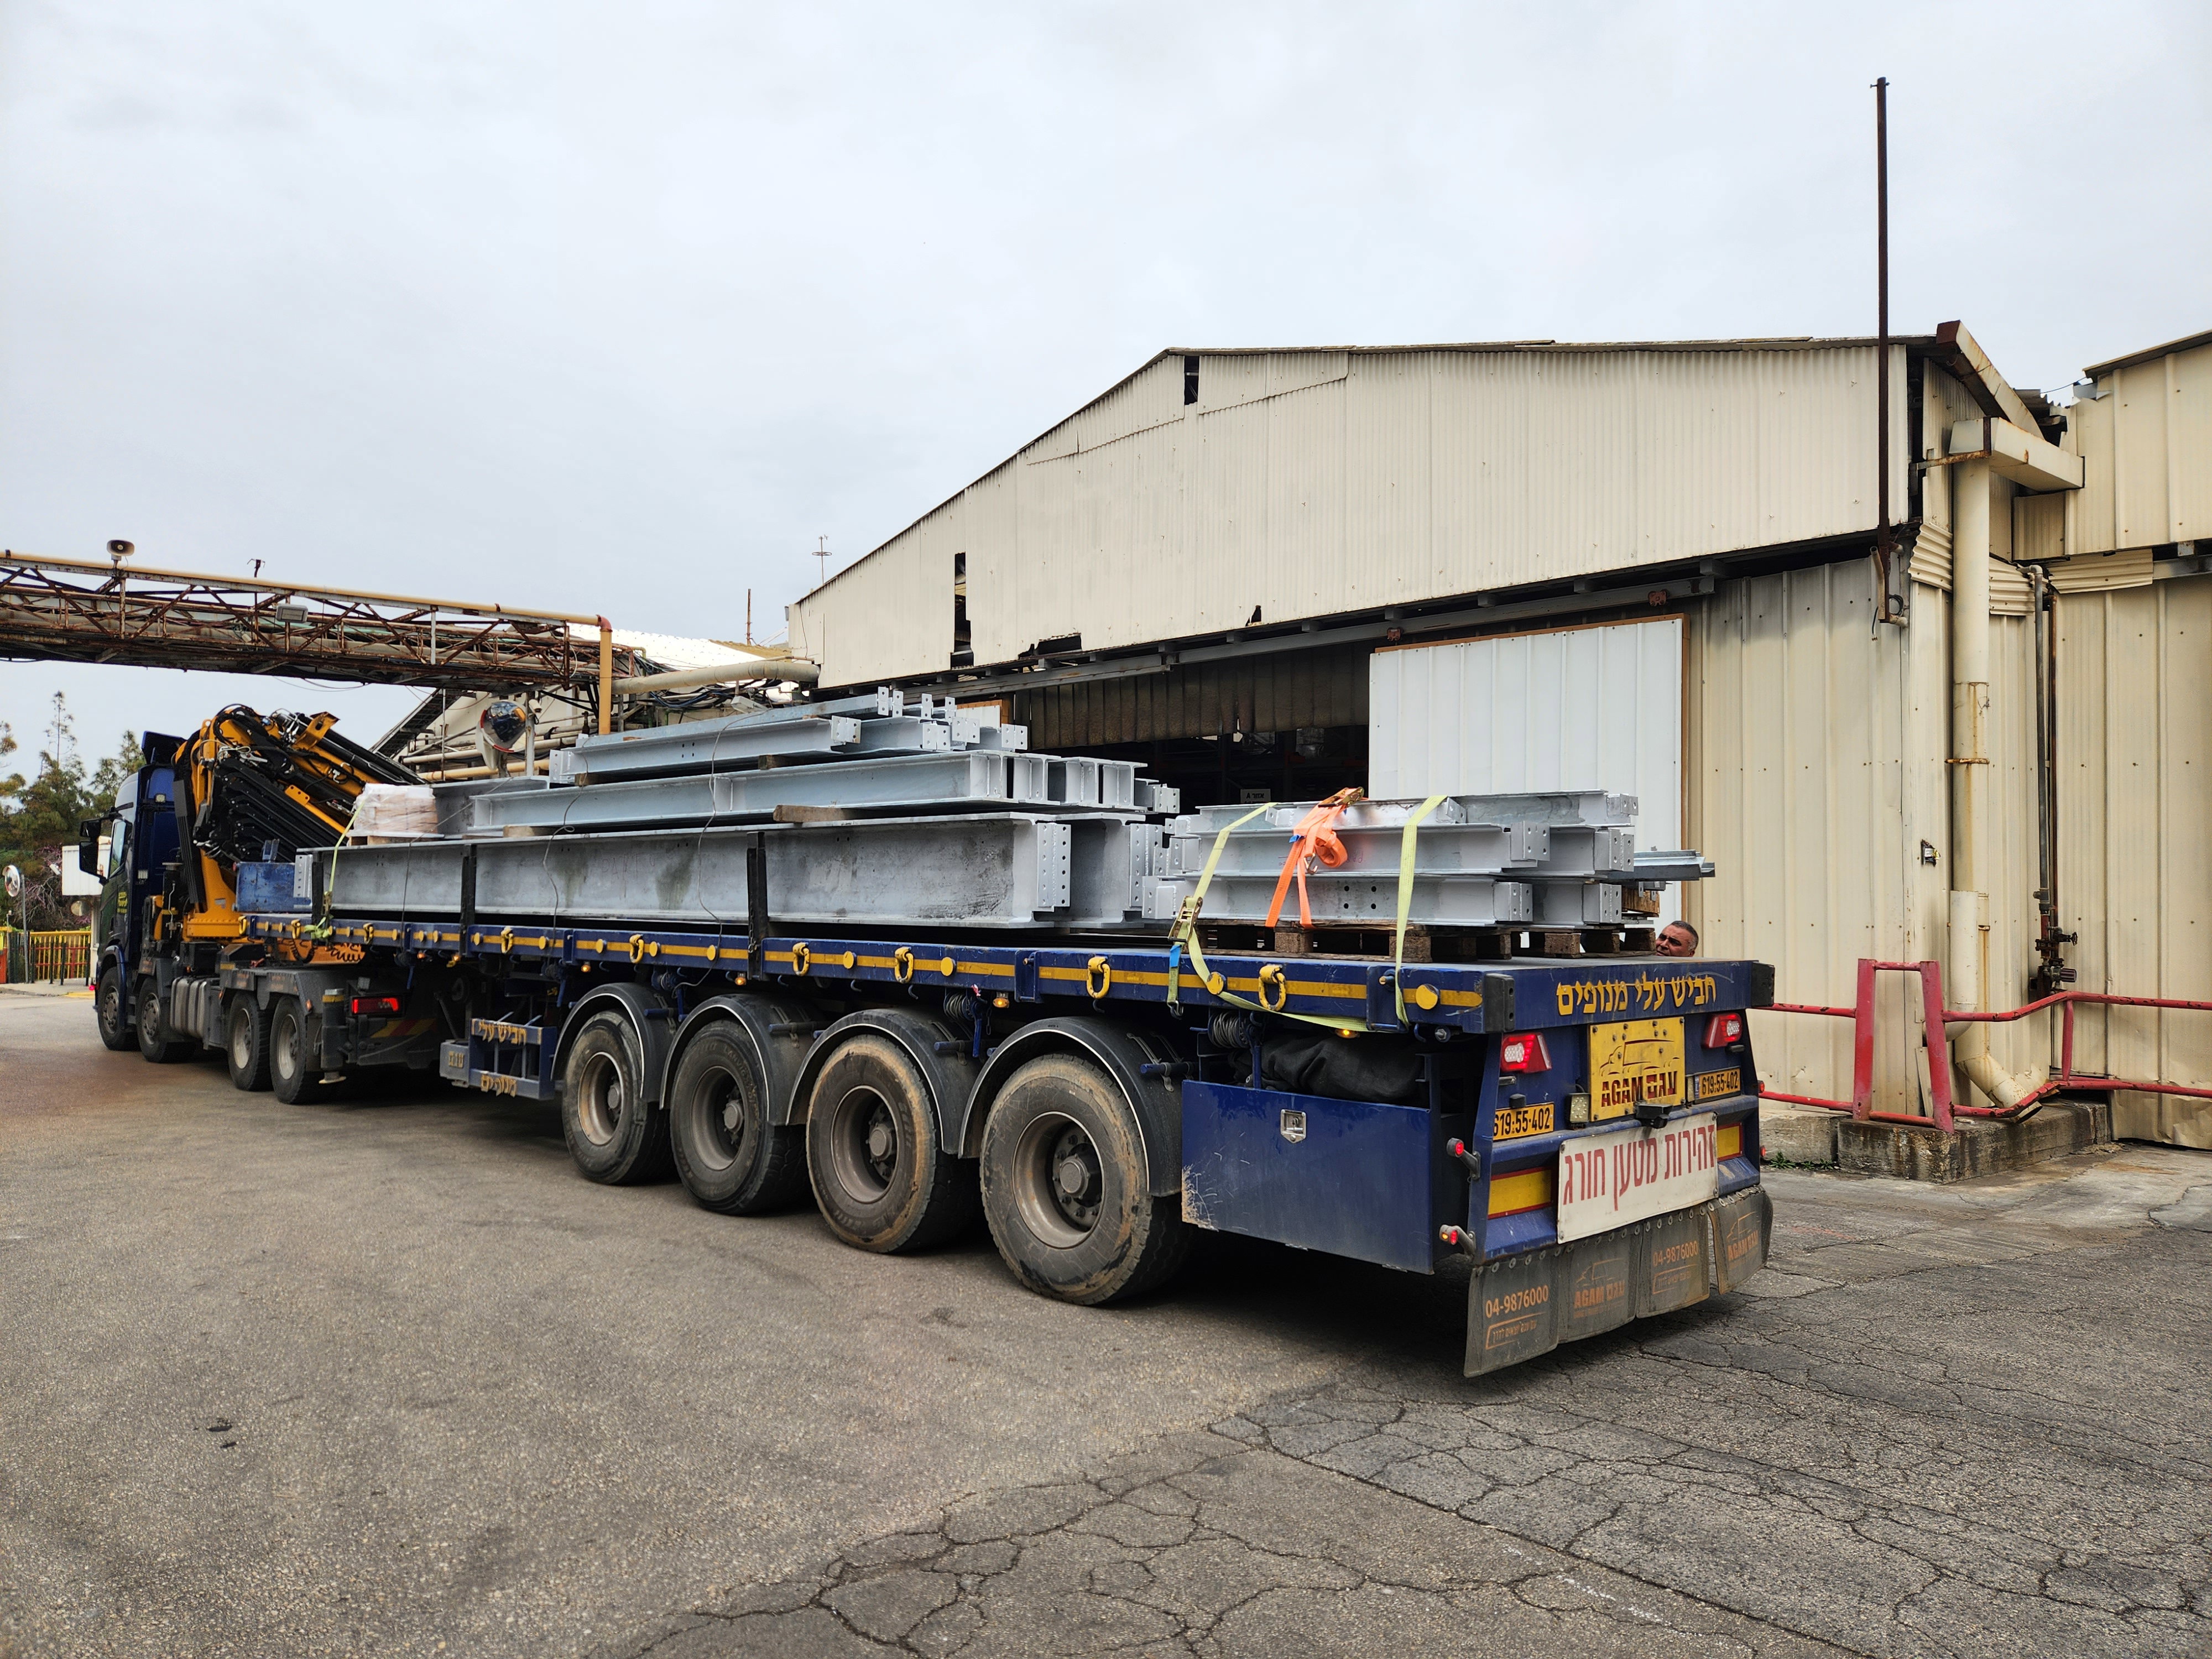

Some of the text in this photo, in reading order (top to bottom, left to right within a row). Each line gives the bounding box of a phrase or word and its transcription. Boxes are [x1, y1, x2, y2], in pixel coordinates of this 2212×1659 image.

[1556, 971, 1717, 1016] חביש עלי מנופים
[478, 1019, 527, 1046] חביש עלי
[1601, 1076, 1644, 1108] AGAM
[1645, 1070, 1678, 1099] עגם
[1563, 1124, 1715, 1212] זהירות מטען חורג
[1652, 1240, 1698, 1267] 04-9876000
[1485, 1285, 1549, 1318] 04-9876000
[1573, 1286, 1605, 1310] AGAM
